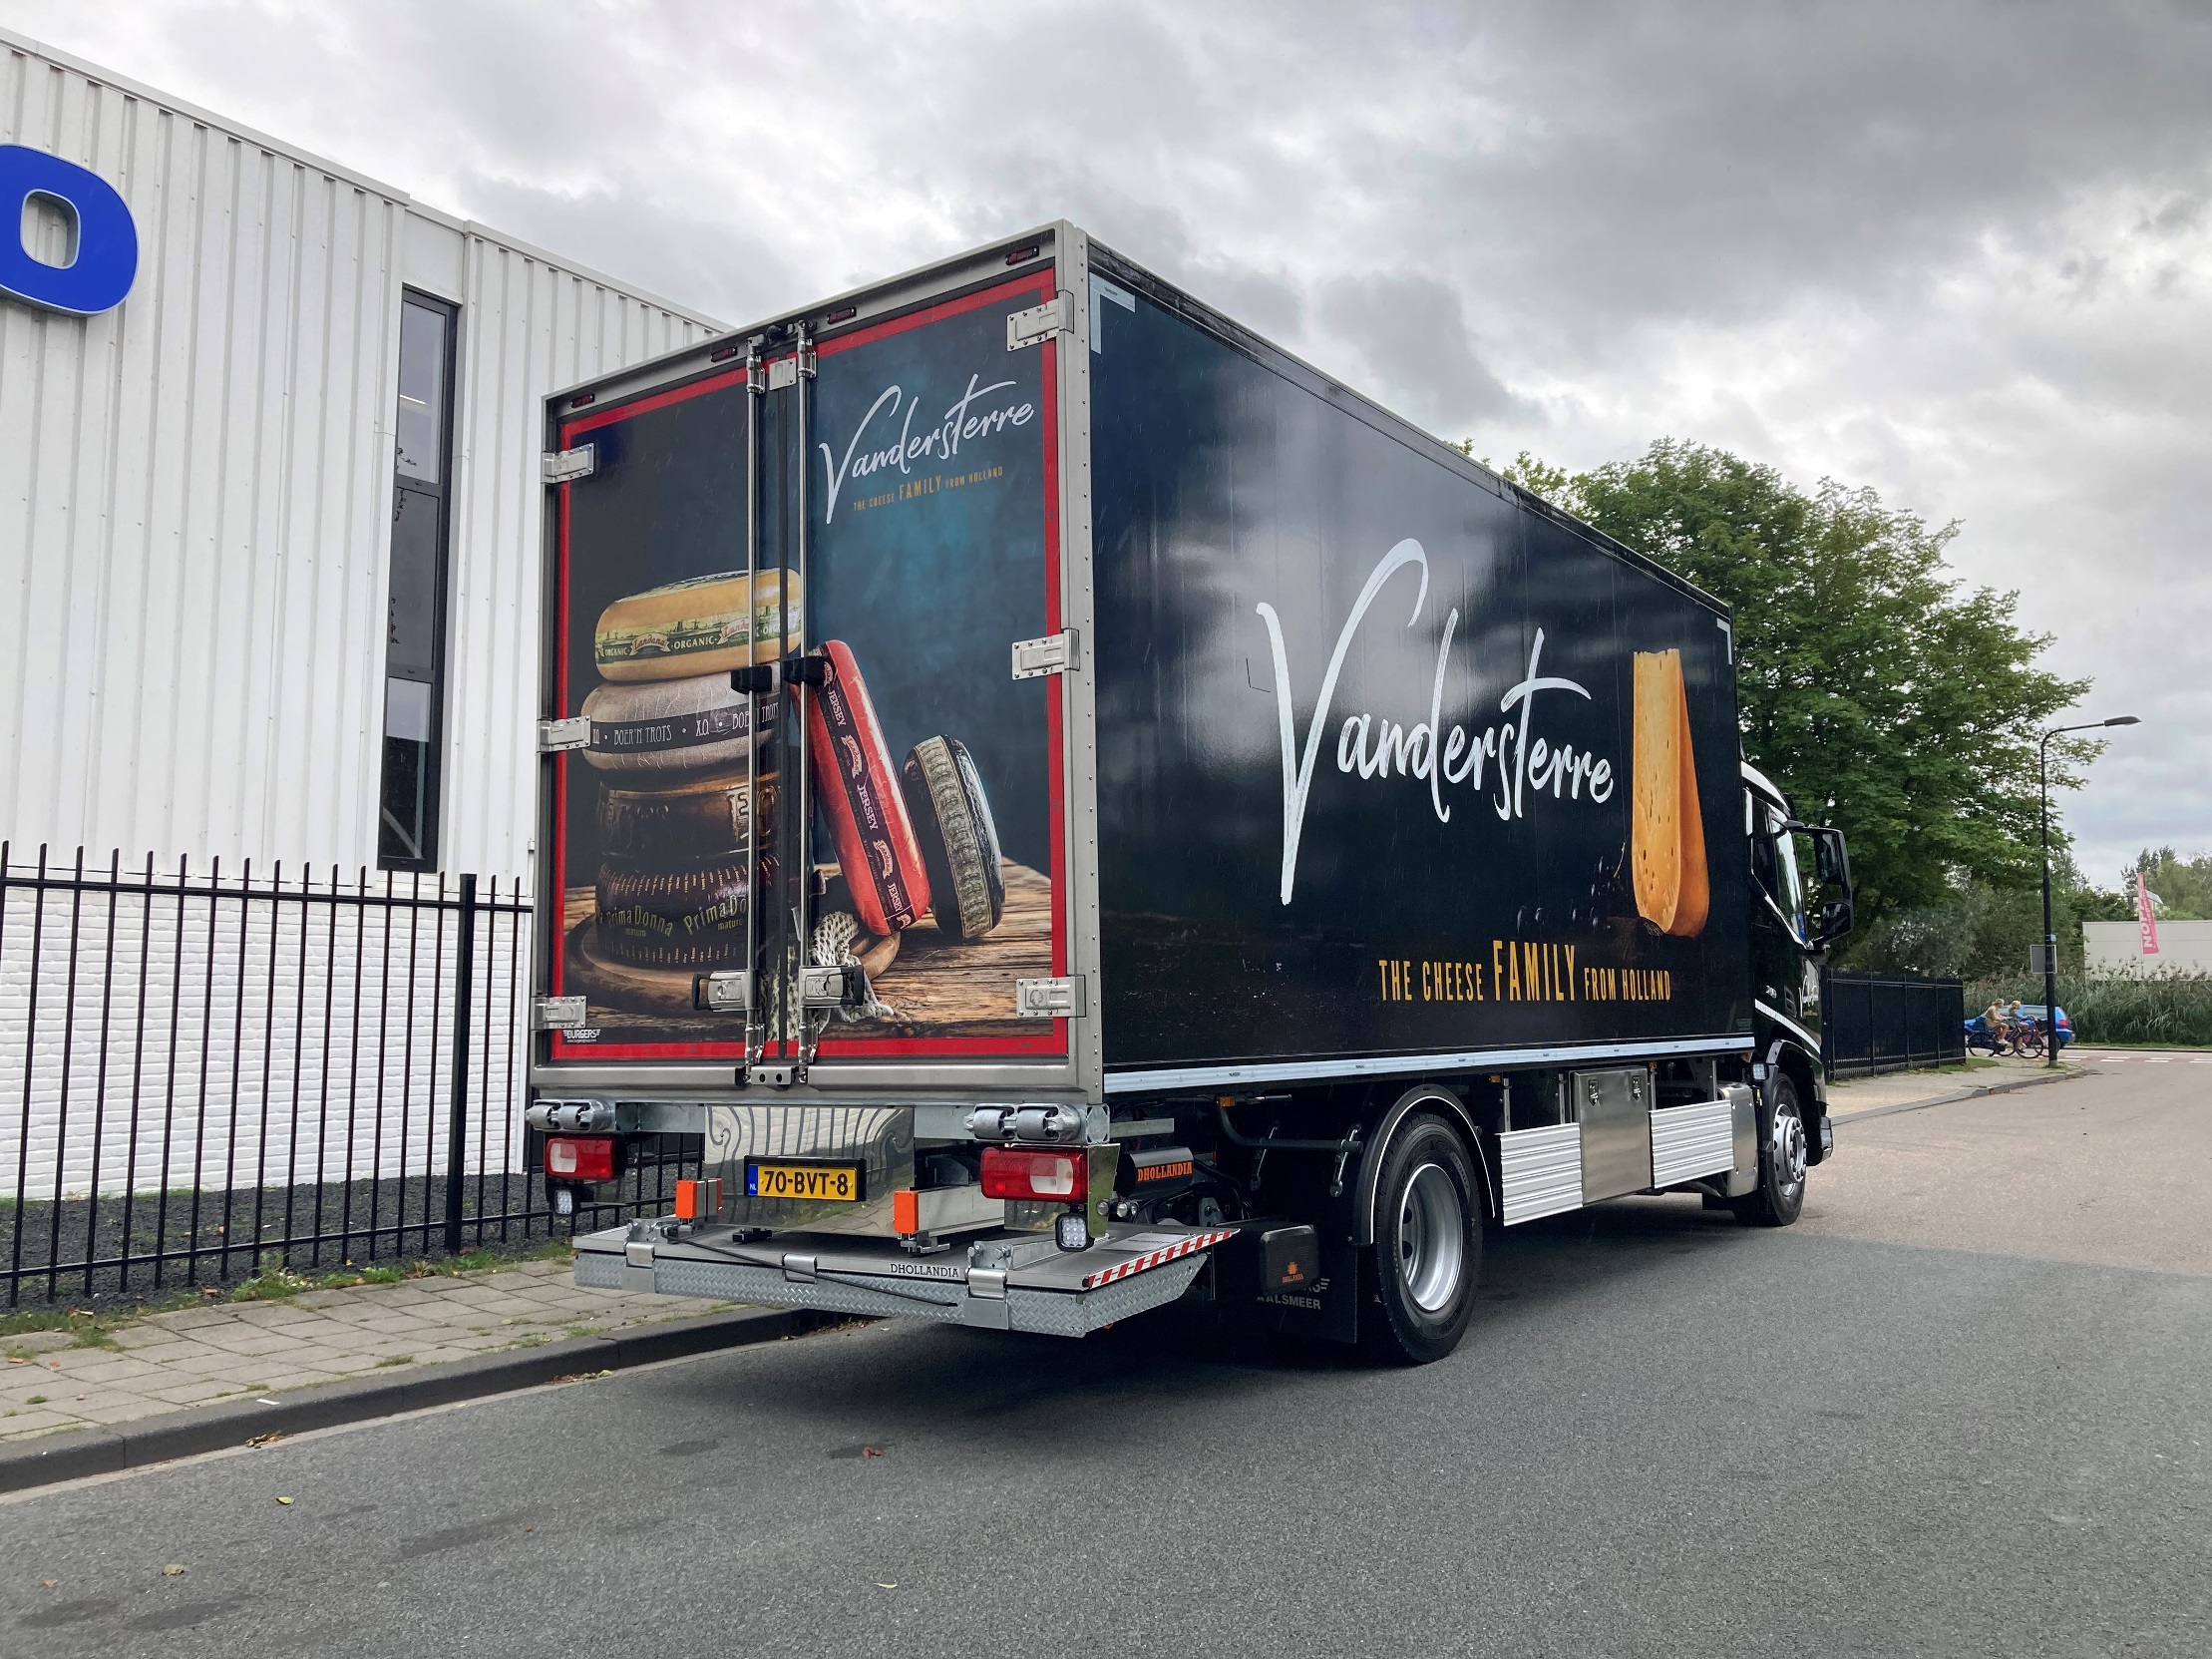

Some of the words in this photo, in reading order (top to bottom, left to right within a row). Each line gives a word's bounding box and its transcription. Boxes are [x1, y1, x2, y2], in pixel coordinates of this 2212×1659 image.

[819, 373, 1034, 525] Vandersterre
[853, 501, 866, 511] THE
[899, 475, 941, 501] FAMILY
[945, 477, 964, 489] FROM
[968, 466, 1003, 484] HOLLAND
[673, 635, 715, 649] ORGANIC
[644, 724, 672, 743] TROTS
[1256, 538, 1614, 906] Vandersterre
[828, 689, 847, 726] JERSEY
[857, 784, 879, 830] JERSEY
[887, 882, 904, 912] JERSEY
[1378, 960, 1412, 1001] THE
[1422, 961, 1483, 1001] CHEESE
[1493, 940, 1575, 1001] FAMILY
[1584, 967, 1616, 1001] FROM
[1622, 969, 1670, 1001] HOLLAND
[565, 1029, 598, 1039] BURGERS
[764, 1170, 849, 1196] 70-BVT-8
[1138, 1161, 1193, 1182] DHOLLANDIA
[890, 1263, 959, 1278] DHOLLANDIA
